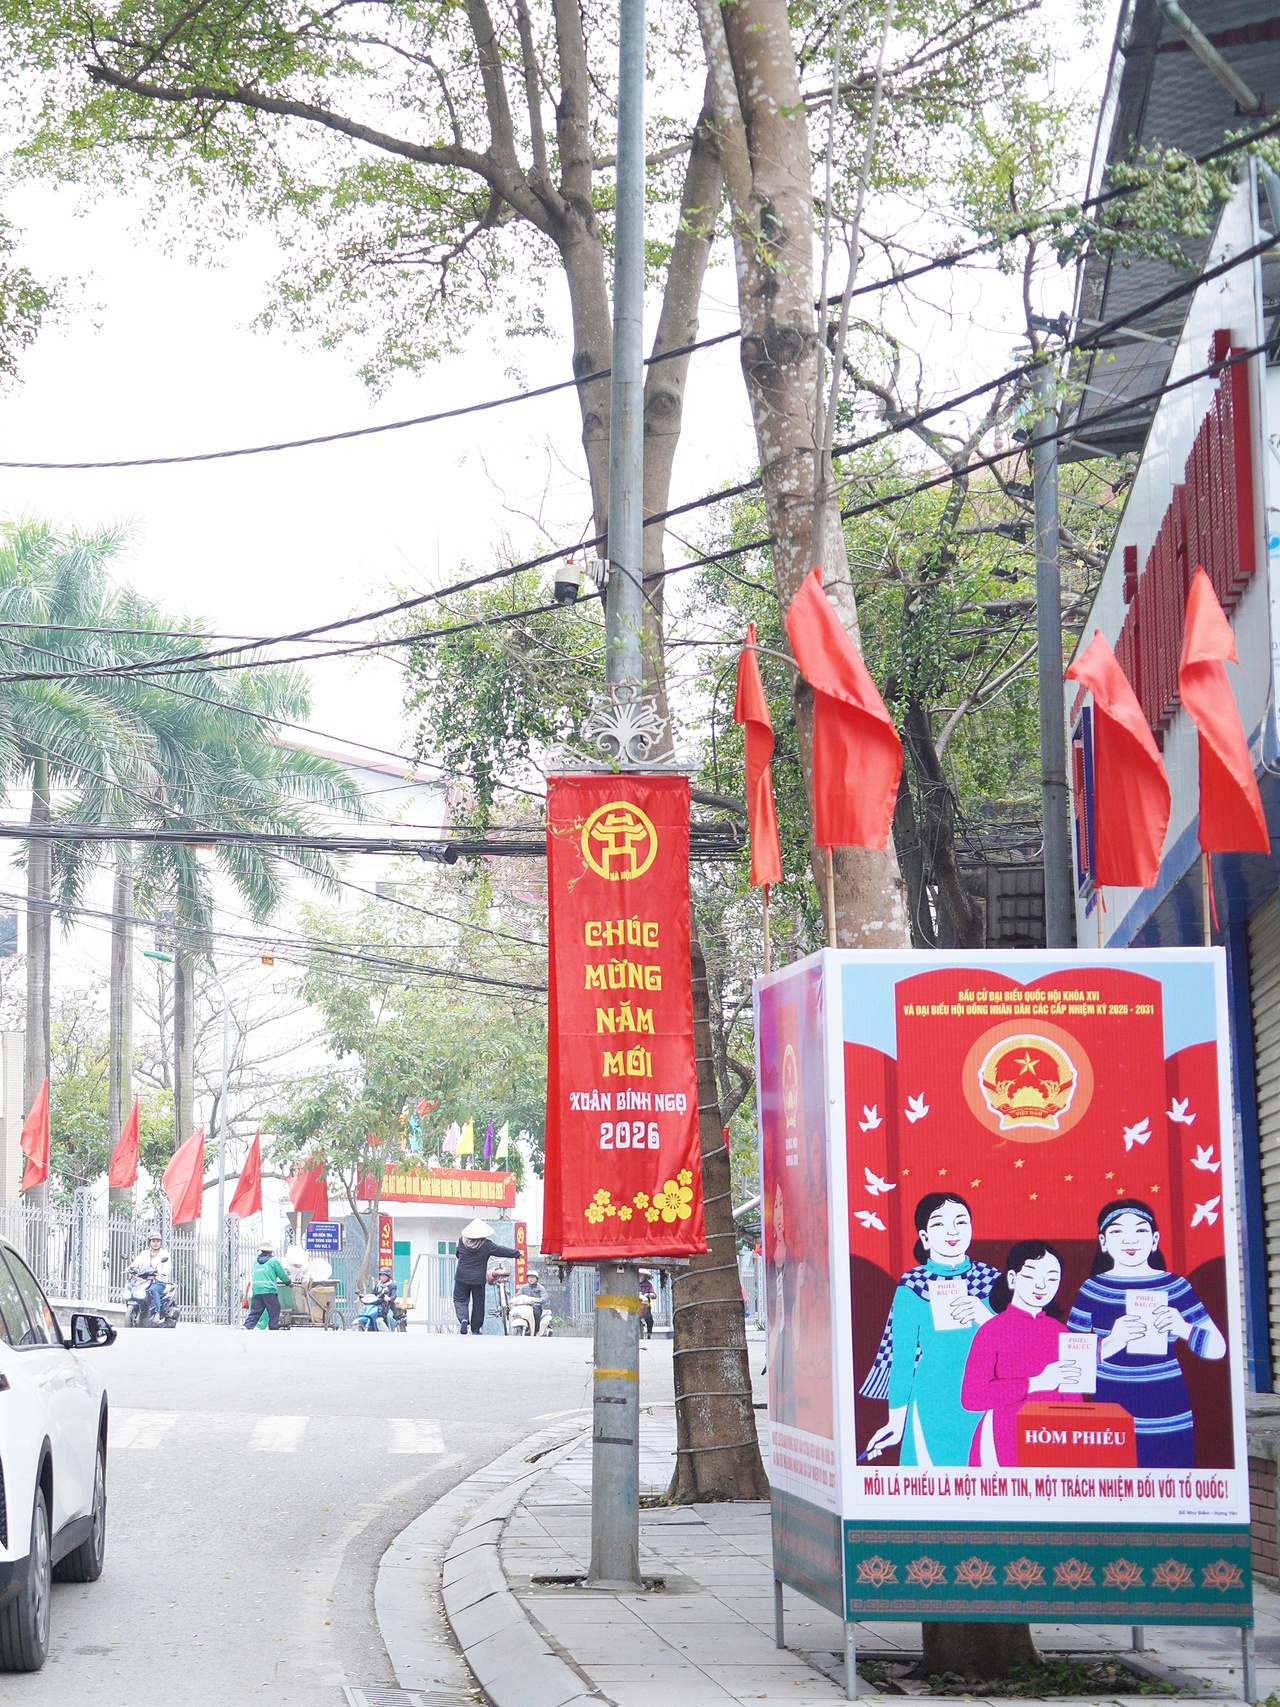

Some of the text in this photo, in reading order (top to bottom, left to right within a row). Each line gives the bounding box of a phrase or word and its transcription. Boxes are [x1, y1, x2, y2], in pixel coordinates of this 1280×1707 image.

[584, 914, 658, 948] CHÚC
[584, 958, 662, 990] MỪNG
[904, 1003, 914, 1016] VÀ
[916, 1004, 930, 1018] ĐẠI
[931, 1001, 949, 1016] BIỂU
[951, 1002, 964, 1016] HỘI
[990, 1002, 1012, 1015] NHÂN
[1014, 1002, 1030, 1015] DÂN
[1032, 1002, 1048, 1014] CÁC
[1050, 1000, 1066, 1014] CẤP
[1068, 1002, 1095, 1016] NHIỆM
[1108, 1004, 1128, 1015] 2026
[1136, 1004, 1154, 1014] 2031
[958, 988, 1100, 1004] BẦU CỬ ĐẠI BIỂU QUỐC HỘI KHÓA XVI
[595, 1000, 655, 1034] NĂM
[602, 1044, 652, 1078] MỚI
[570, 1088, 687, 1116] XUÂN BÍNH NGỌ
[599, 1121, 660, 1150] 2026
[1025, 1426, 1127, 1446] HÒM PHIẾU
[864, 1470, 1228, 1502] MỖI LÁ PHIẾU LÀ MỘT NIỀM TIN, MỘT TRÁCH NHIỆM ĐỐI VỚI TỔ QUỐC!
